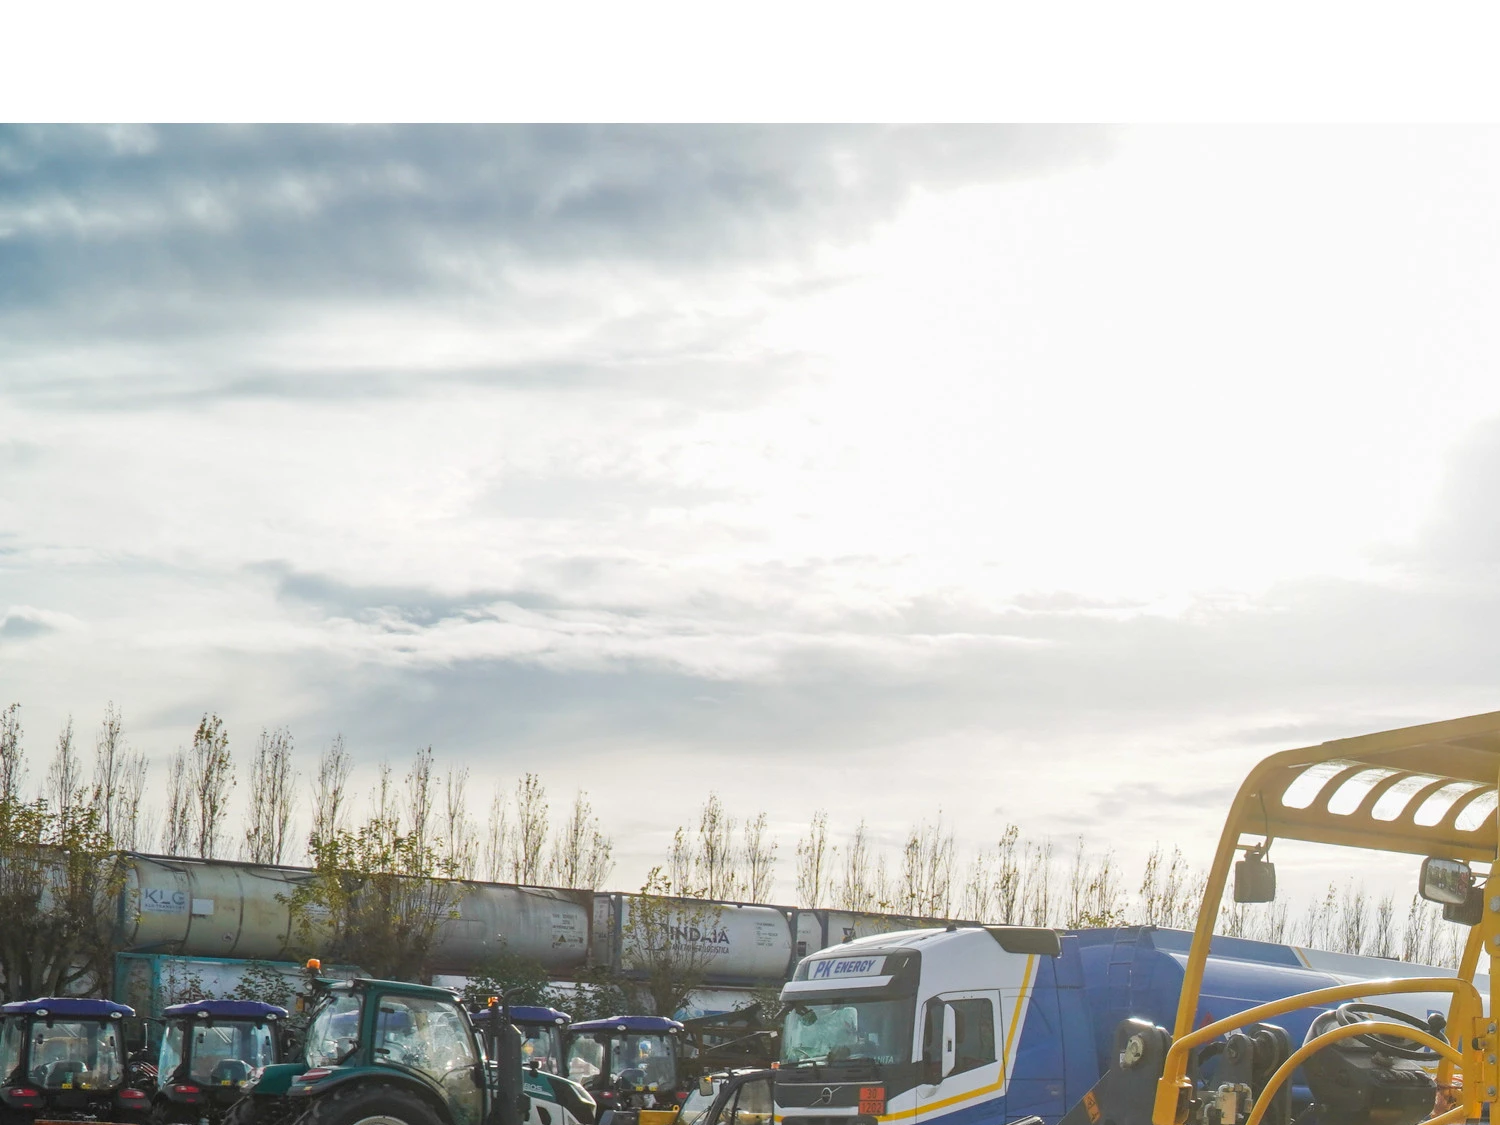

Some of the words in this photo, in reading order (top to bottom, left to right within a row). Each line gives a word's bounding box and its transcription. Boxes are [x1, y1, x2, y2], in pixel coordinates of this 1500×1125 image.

[145, 889, 185, 905] KLG
[814, 960, 835, 978] PK
[834, 960, 877, 974] ENERGY
[867, 1088, 877, 1099] 30
